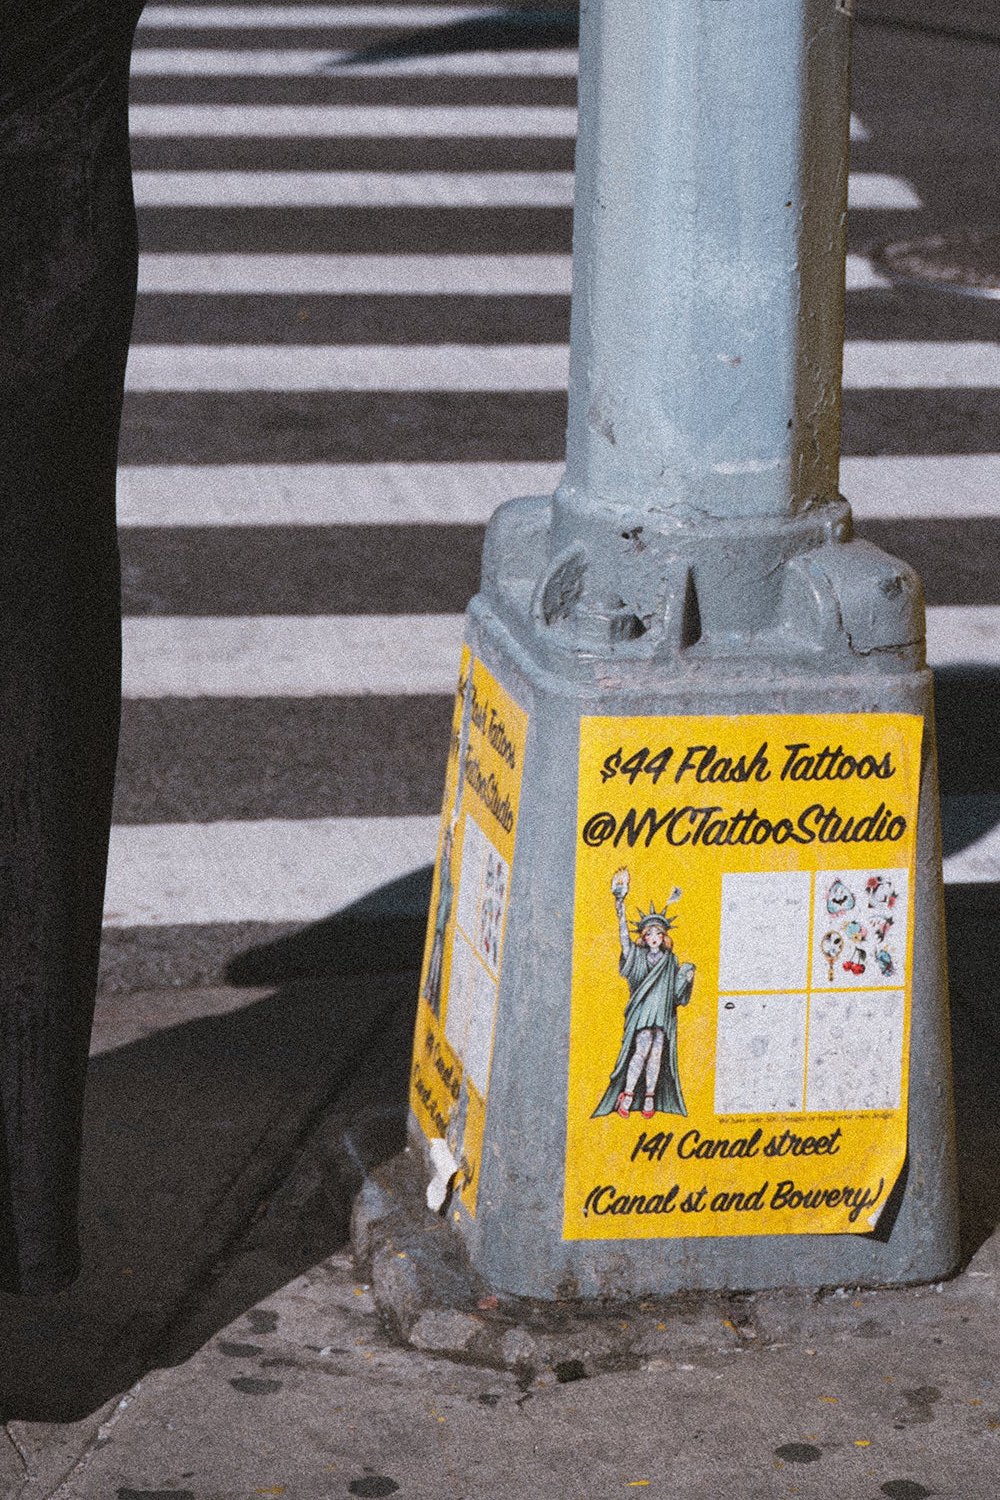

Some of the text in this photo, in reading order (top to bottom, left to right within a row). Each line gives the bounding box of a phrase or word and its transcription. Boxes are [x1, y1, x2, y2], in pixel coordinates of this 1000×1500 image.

[600, 742, 896, 785] $44 Flash Tattoos
[582, 802, 907, 848] @NYCTattooStudio
[630, 1127, 842, 1161] 141 Canal street
[583, 1177, 885, 1223] (Canal st and Bowery)
